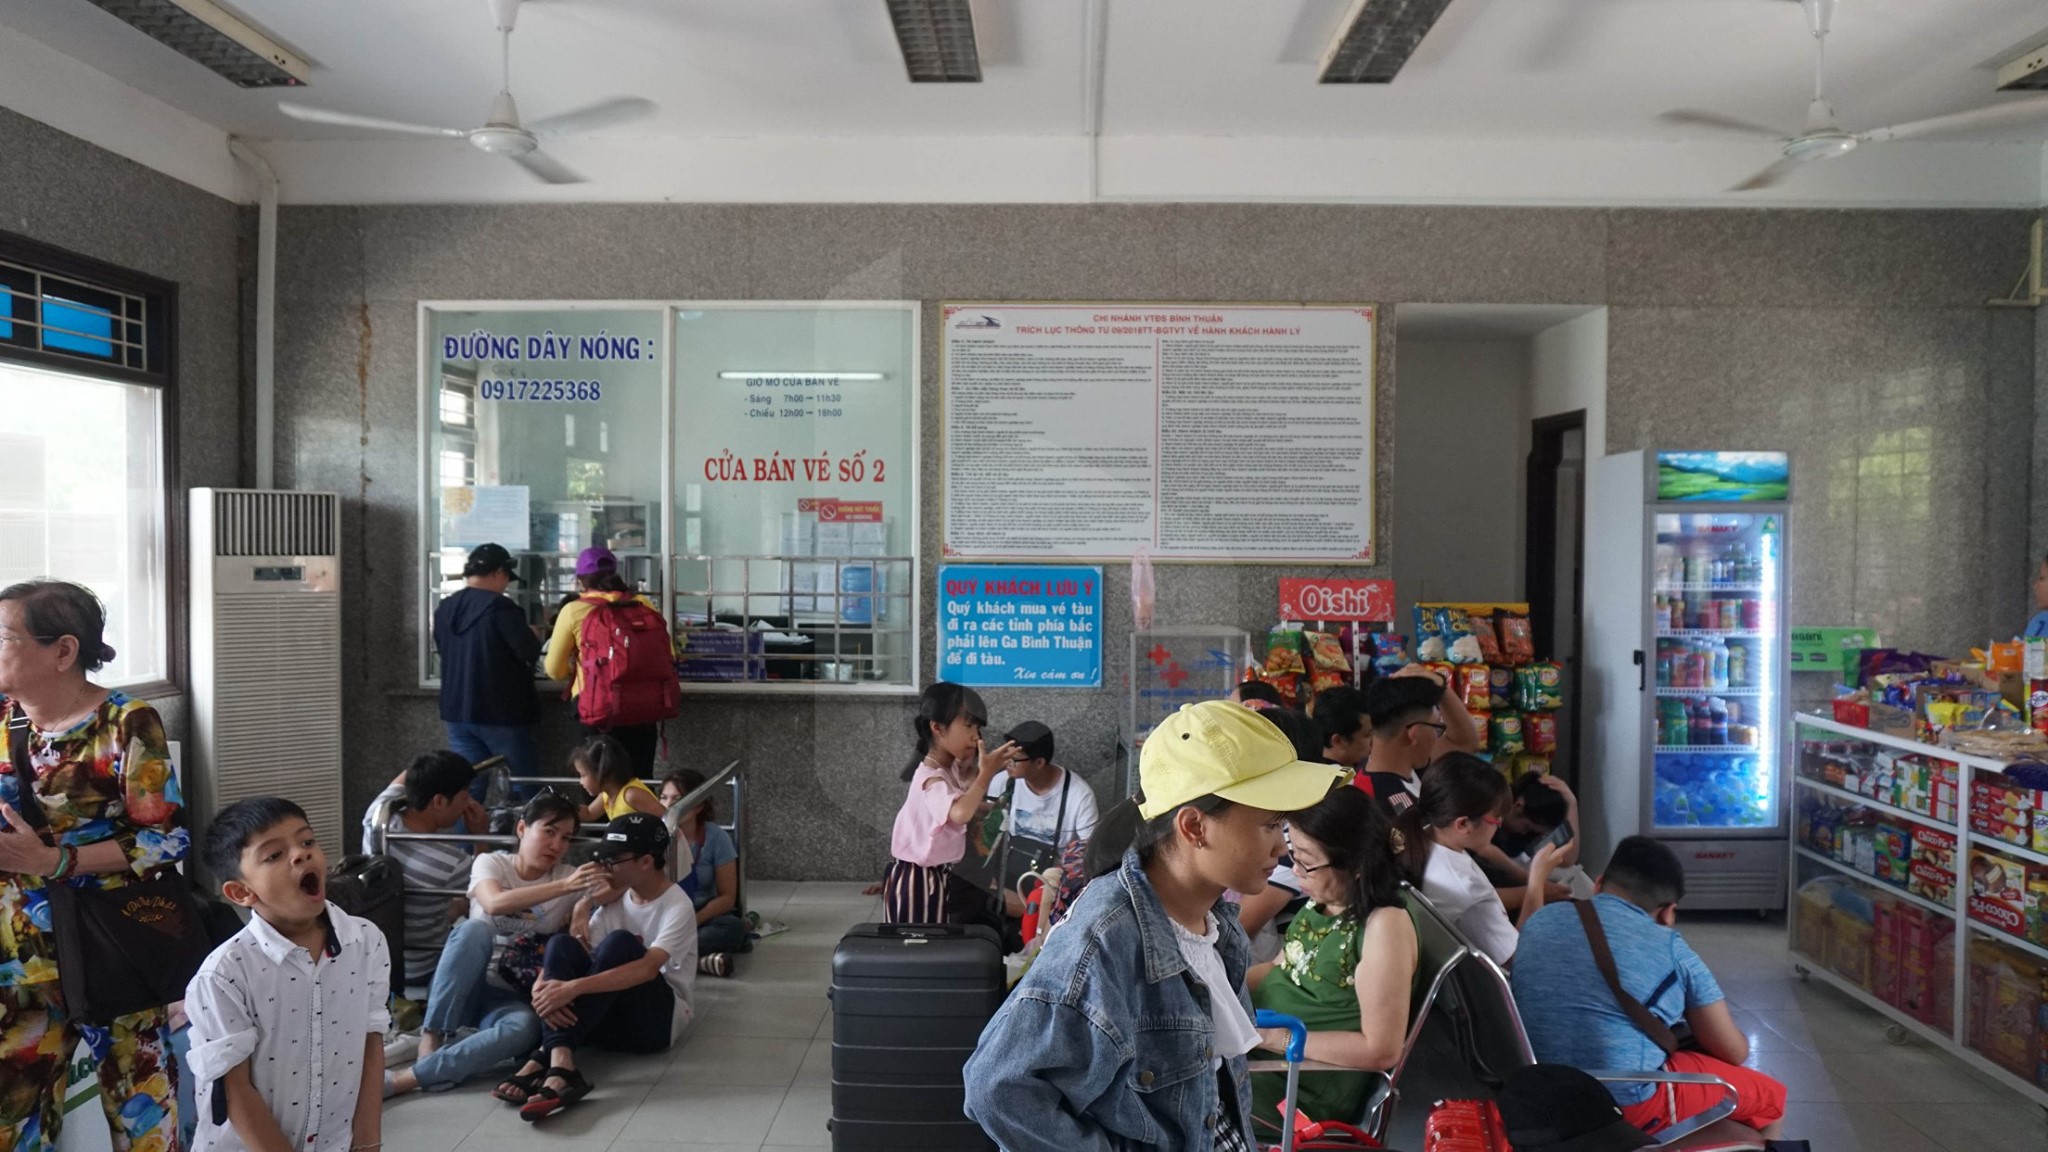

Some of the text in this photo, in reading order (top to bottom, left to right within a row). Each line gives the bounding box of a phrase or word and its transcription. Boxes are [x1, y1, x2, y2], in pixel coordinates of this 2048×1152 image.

[1093, 314, 1108, 322] CHI
[1110, 312, 1141, 322] NHÁNH
[1016, 325, 1042, 334] TRÍCH
[1065, 325, 1095, 334] THÔNG
[1229, 326, 1260, 335] KHÁCH
[444, 331, 519, 359] ĐƯỜNG
[527, 330, 571, 359] DÂY
[580, 330, 640, 359] NÓNG
[482, 380, 600, 400] 0917225368
[749, 394, 772, 405] Sáng
[784, 394, 804, 402] 7h00
[816, 394, 841, 402] 11h30
[780, 408, 804, 417] 12h00
[704, 448, 885, 482] CỬA BÁN VÉ SỐ 2
[946, 576, 978, 597] QUÝ
[985, 576, 1041, 595] KHÁCH
[1084, 577, 1094, 595] Ý
[1300, 585, 1370, 615] Oishi
[947, 601, 1093, 616] Quý khách mua vé tàu
[947, 617, 1093, 634] đi ra các tỉnh phía bắc
[947, 634, 1092, 652] phải lên Ga Bình Thuận
[947, 650, 1006, 665] để đi tàu.
[1014, 667, 1037, 679] Xin
